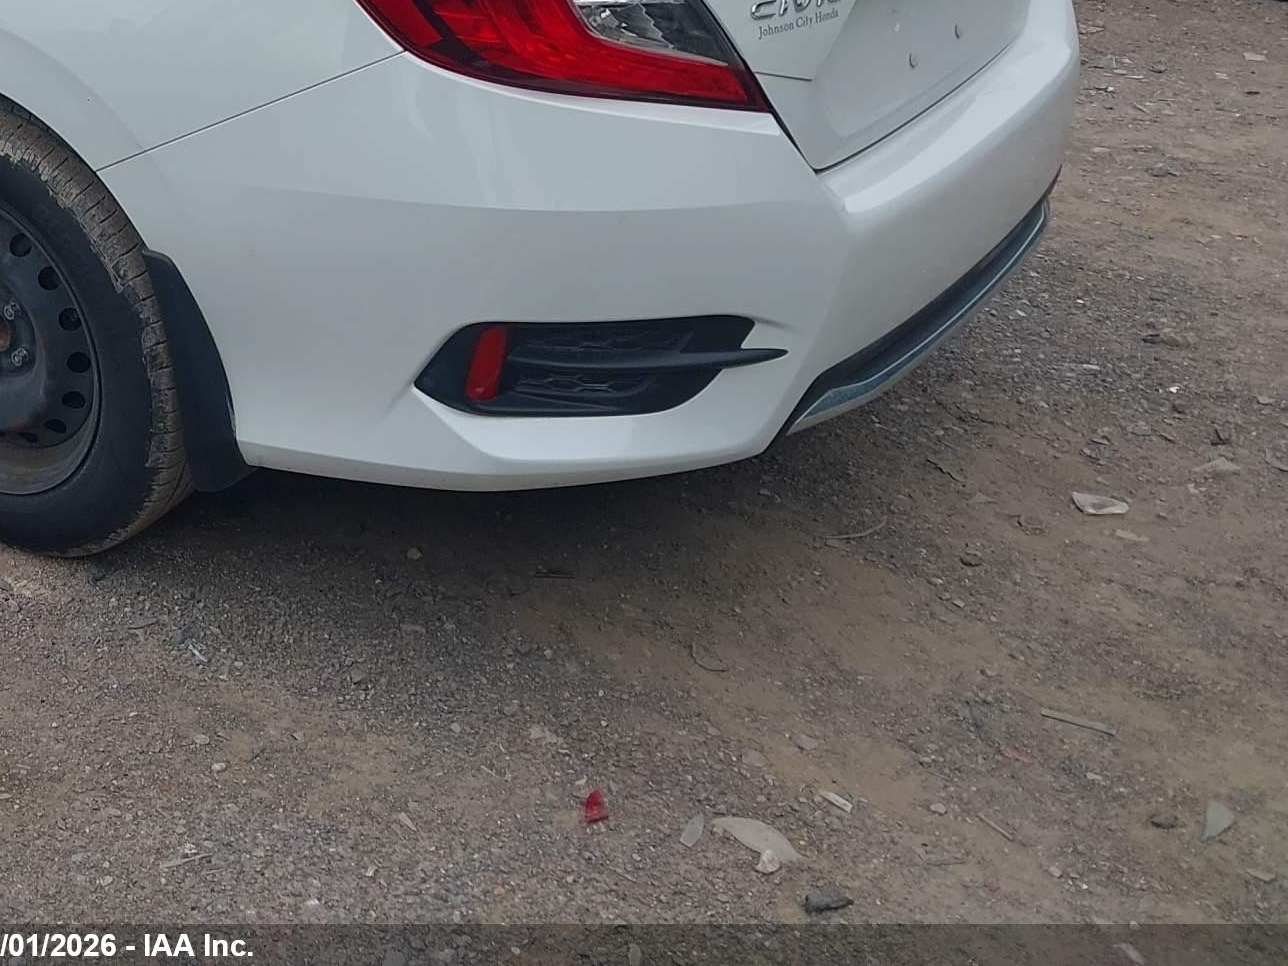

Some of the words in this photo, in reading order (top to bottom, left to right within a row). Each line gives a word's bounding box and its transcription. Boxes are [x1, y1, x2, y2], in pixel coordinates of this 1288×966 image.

[758, 22, 795, 40] Johnson
[795, 16, 813, 29] City
[815, 7, 840, 24] Honda
